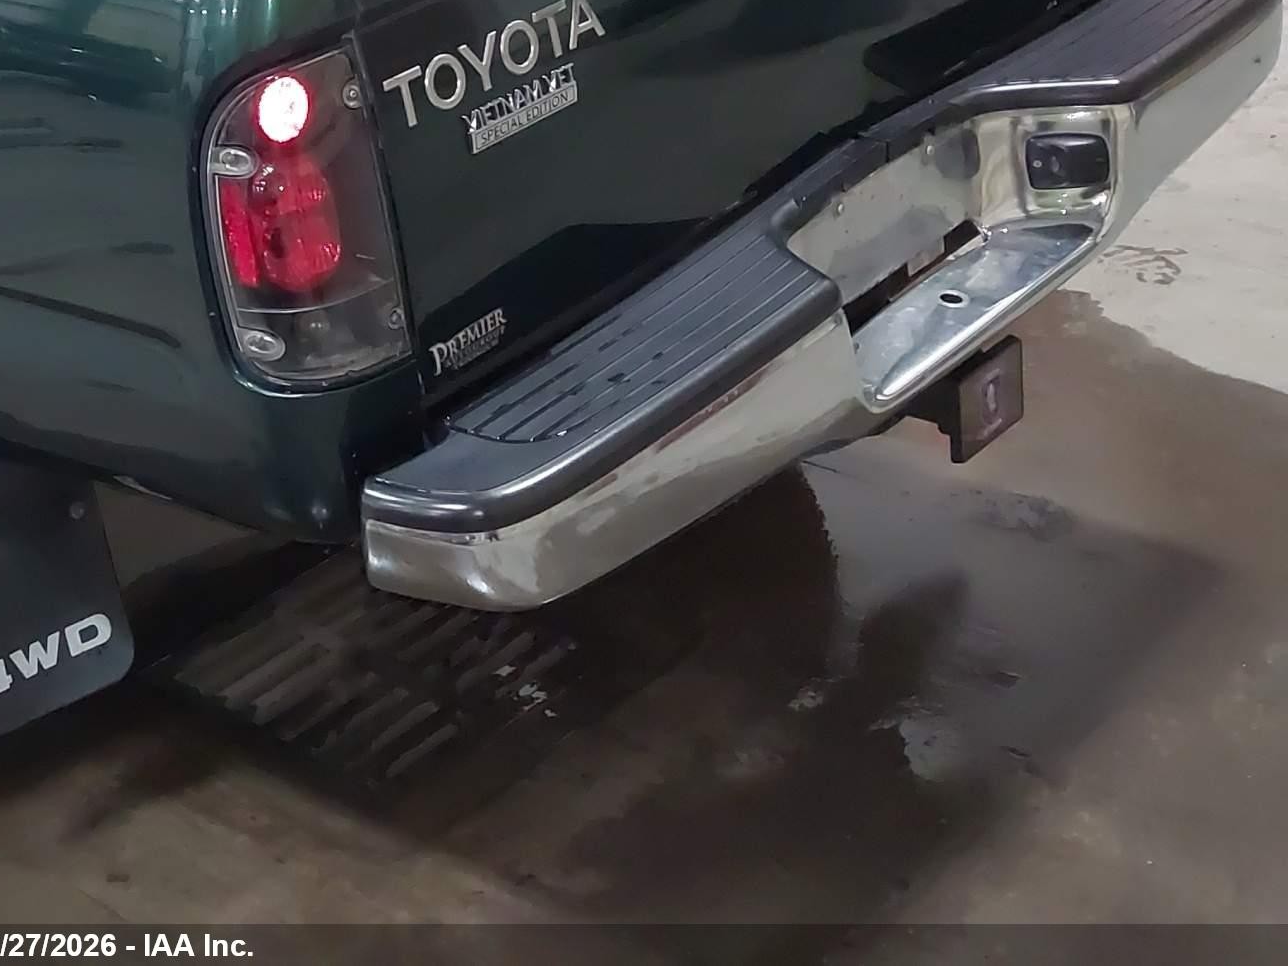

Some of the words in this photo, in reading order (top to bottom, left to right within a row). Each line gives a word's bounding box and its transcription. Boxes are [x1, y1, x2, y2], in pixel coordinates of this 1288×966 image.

[462, 79, 543, 132] VIETNAM
[542, 63, 574, 93] VET
[481, 114, 522, 144] SPECIAL
[526, 91, 569, 121] EDITION
[428, 308, 507, 376] PREMIER
